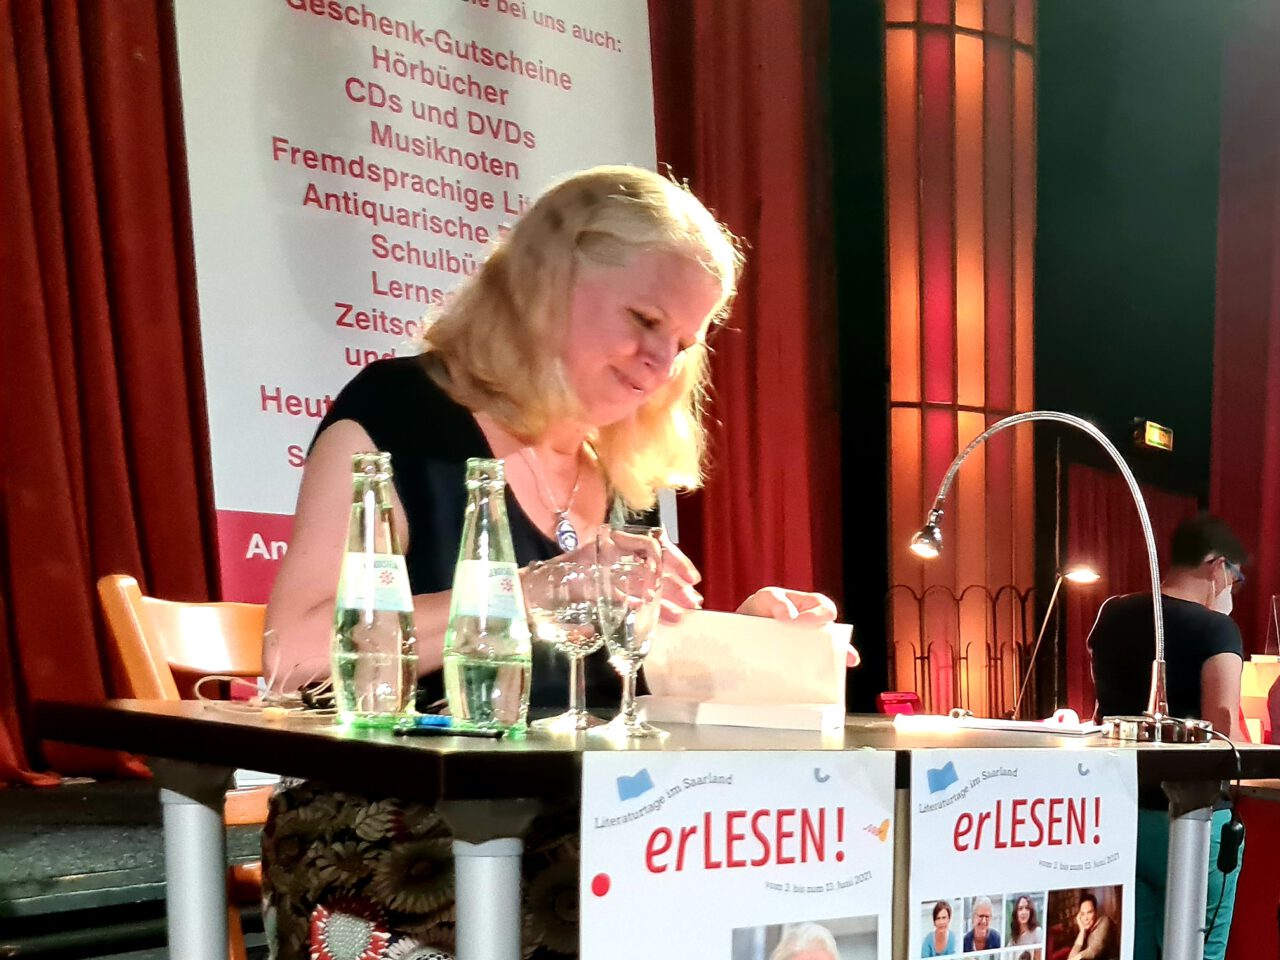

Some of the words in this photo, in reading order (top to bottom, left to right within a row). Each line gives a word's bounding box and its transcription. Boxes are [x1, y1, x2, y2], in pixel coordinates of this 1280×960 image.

[497, 0, 527, 19] bei
[532, 10, 566, 33] uns
[572, 23, 622, 53] auch:
[371, 44, 510, 106] Hörbücher
[344, 76, 403, 114] CDs
[411, 98, 459, 130] und
[467, 111, 537, 150] DVDs
[271, 135, 495, 213] Fremdsprachige
[503, 190, 533, 217] Li
[370, 120, 521, 180] Musiknoten
[302, 183, 489, 244] Antiquarische
[371, 233, 485, 277] Schulbü
[371, 270, 456, 306] Lerns
[334, 302, 424, 337] Zeitsc
[666, 785, 682, 798] im
[683, 772, 733, 790] Saarland
[982, 766, 1018, 781] Saarland
[644, 806, 846, 874] erLESEN!
[953, 796, 1101, 852] erLESEN!
